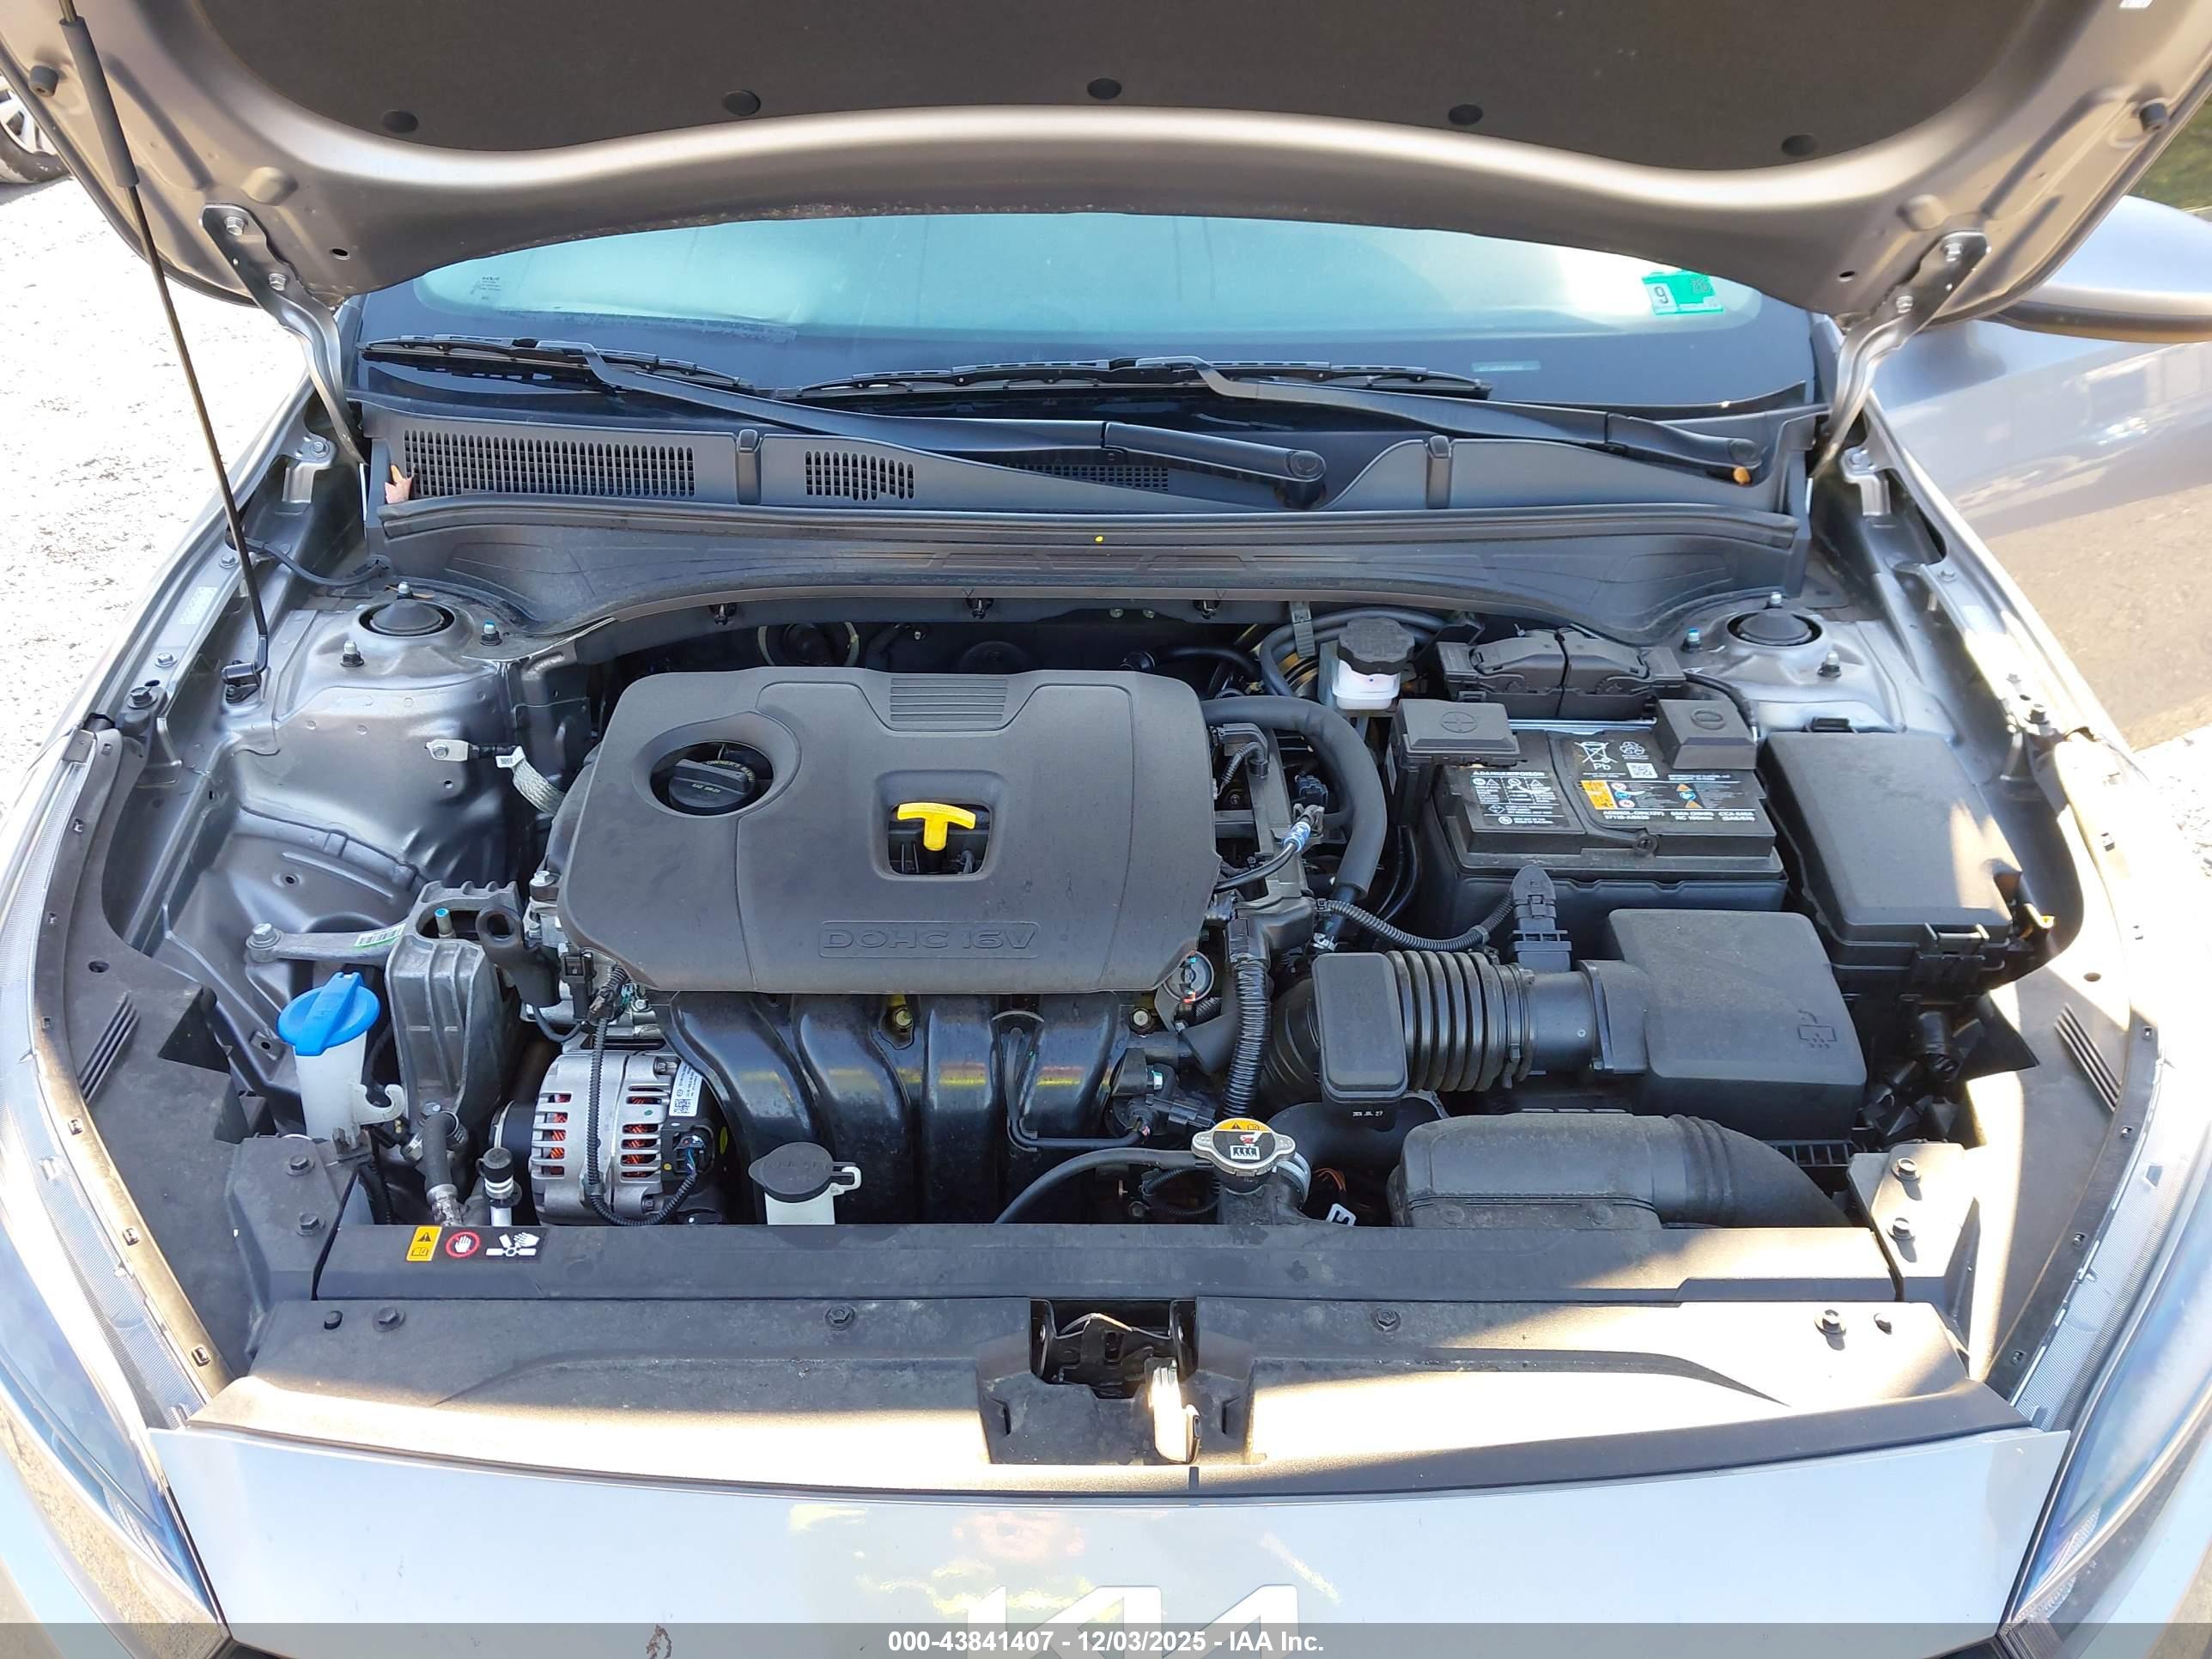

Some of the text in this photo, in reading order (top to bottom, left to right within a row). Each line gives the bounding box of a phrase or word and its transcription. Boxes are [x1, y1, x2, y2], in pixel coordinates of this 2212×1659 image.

[1654, 286, 1669, 304] 9
[1593, 763, 1612, 772] Pb
[823, 930, 1036, 949] DOHC 16V
